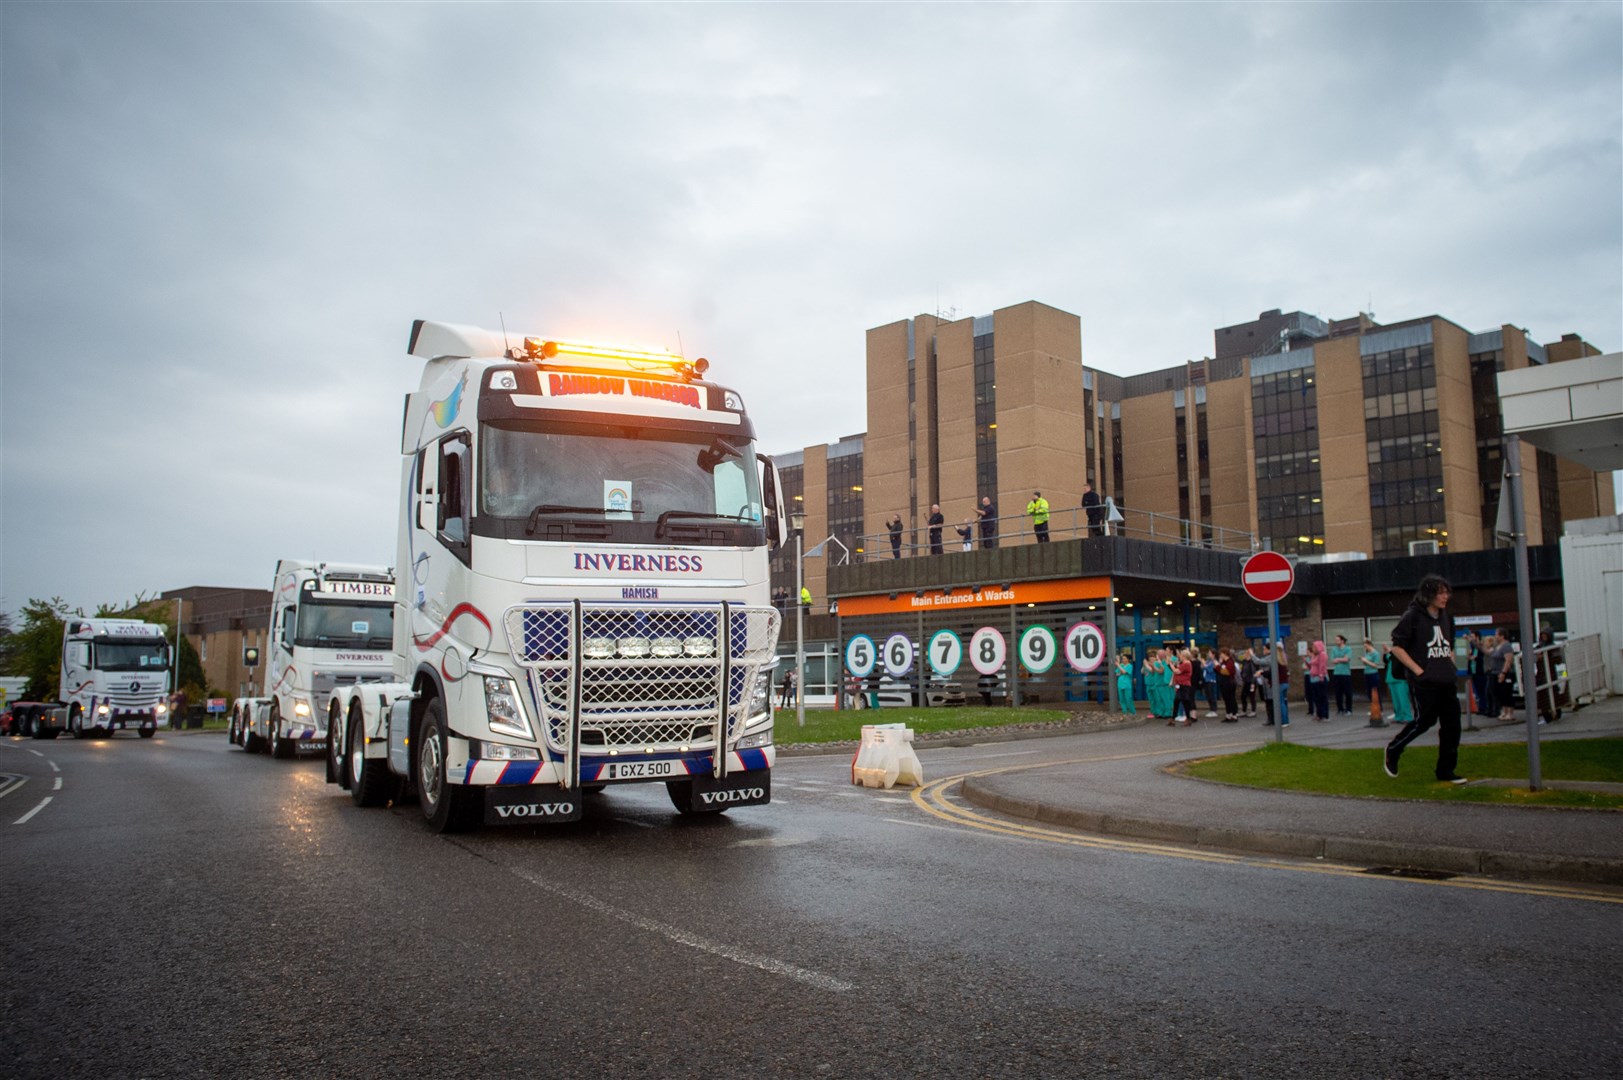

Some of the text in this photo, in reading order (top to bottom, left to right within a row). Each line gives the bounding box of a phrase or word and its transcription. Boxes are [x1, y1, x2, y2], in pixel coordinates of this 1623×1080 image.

[548, 373, 702, 410] RAINBOW WARRIOR
[574, 552, 703, 573] INVERNESS
[329, 582, 393, 596] TIMBER
[622, 587, 659, 600] HAMISH
[911, 590, 1015, 607] Main Entrance & Wards
[854, 644, 868, 668] 5
[890, 642, 906, 667] 6
[937, 640, 952, 665] 7
[980, 637, 996, 664] 8
[1028, 635, 1047, 662] 9
[1070, 633, 1100, 660] 10
[1427, 646, 1451, 659] ATAR
[336, 653, 384, 661] INVERNESS
[620, 762, 671, 777] GXZ 500
[700, 787, 765, 804] VOLVO
[494, 802, 574, 818] VOLVO
